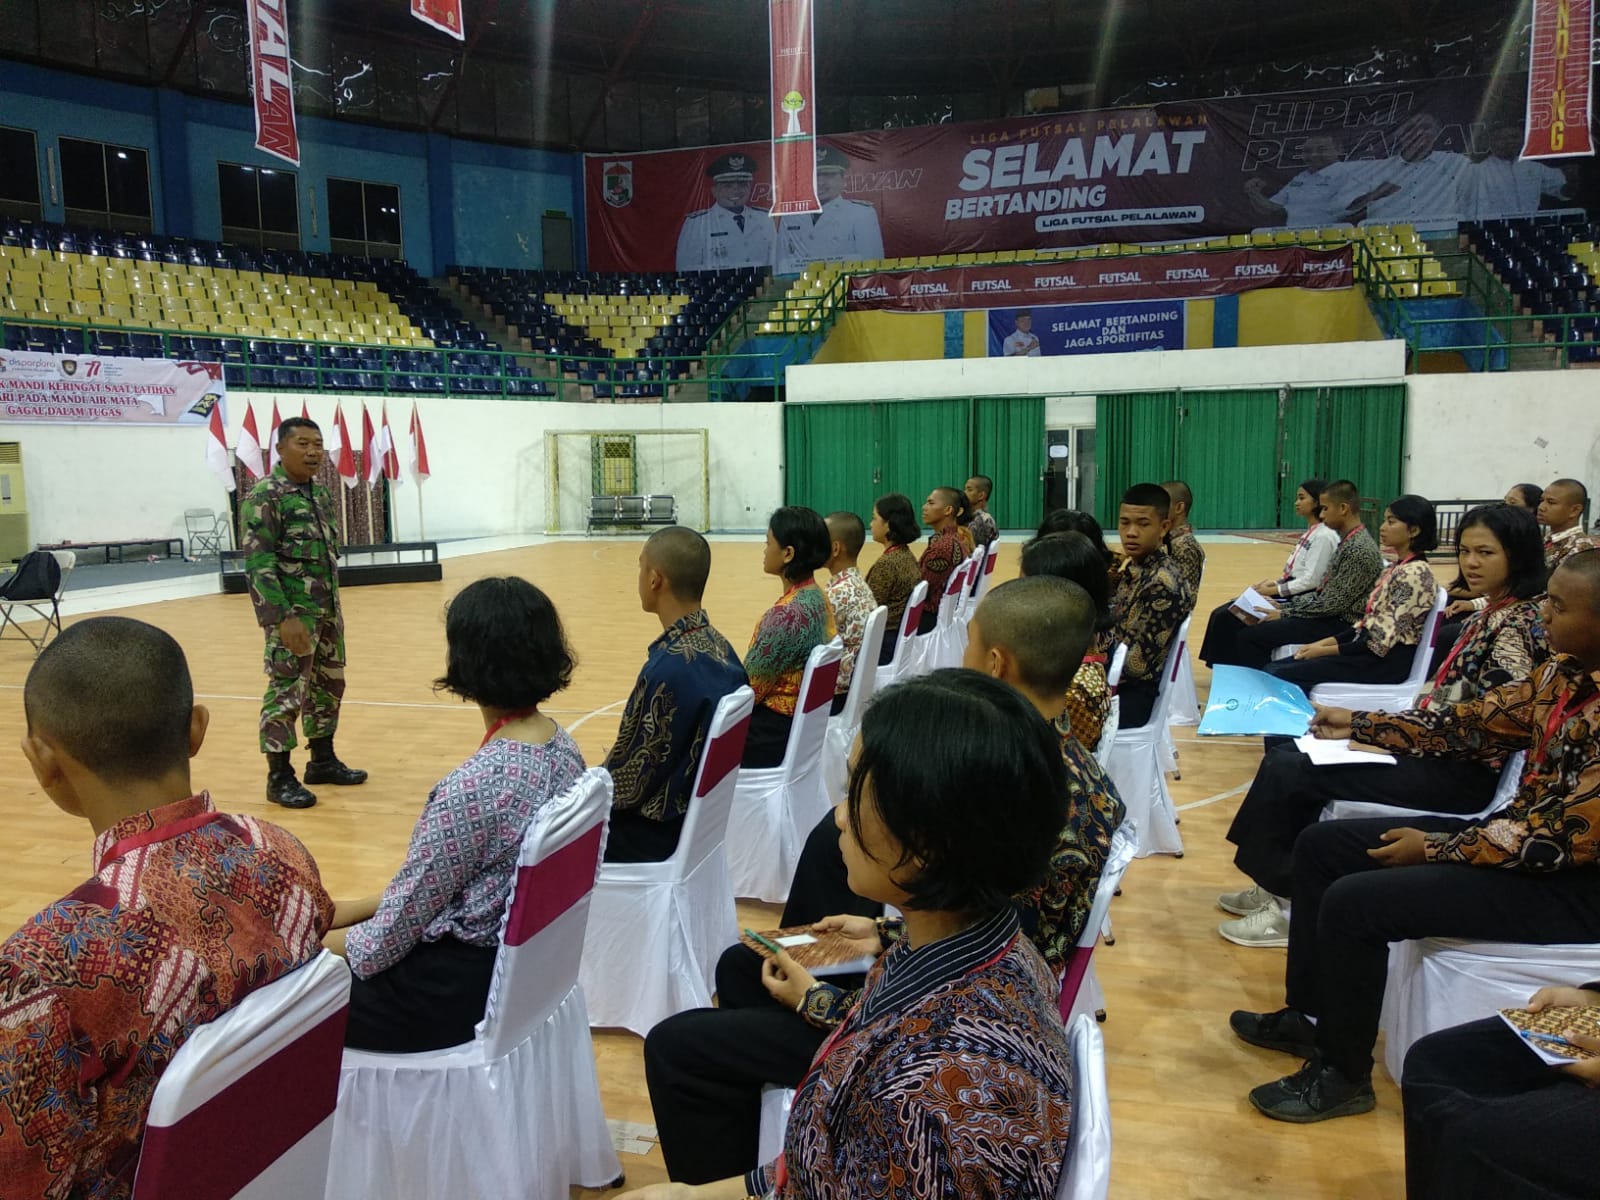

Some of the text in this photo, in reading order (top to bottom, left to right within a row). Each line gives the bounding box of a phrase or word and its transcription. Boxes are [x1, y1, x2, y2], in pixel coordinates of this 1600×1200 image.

[1249, 91, 1414, 136] HIPMI
[969, 115, 1209, 146] LIGA FUTSAL PELALAWAN
[958, 130, 1206, 191] SELAMAT
[944, 184, 1107, 221] BERTANDING
[1042, 209, 1197, 229] LIGA FUTSAL PELALAWAN
[1165, 267, 1210, 280] FUTSAL
[1234, 263, 1281, 276] FUTSAL
[1034, 275, 1077, 288] FUTSAL
[1098, 271, 1142, 285] FUTSAL
[910, 282, 949, 295] FUTSAL
[971, 279, 1012, 291] FUTSAL
[852, 287, 889, 300] FUTSAL
[1051, 310, 1179, 333] SELAMAT BERTANDING
[1101, 326, 1127, 337] DAN
[1064, 329, 1165, 349] JAGA SPORTIFITAS
[9, 380, 45, 390] MANDI
[48, 381, 102, 392] KERINGAT
[104, 384, 130, 393] SAAT
[18, 394, 49, 403] PADA
[51, 395, 86, 404] MANDI
[89, 396, 107, 405] AIR
[110, 397, 139, 405] MATA
[8, 405, 122, 417] GAGAL DALAM TUGAS
